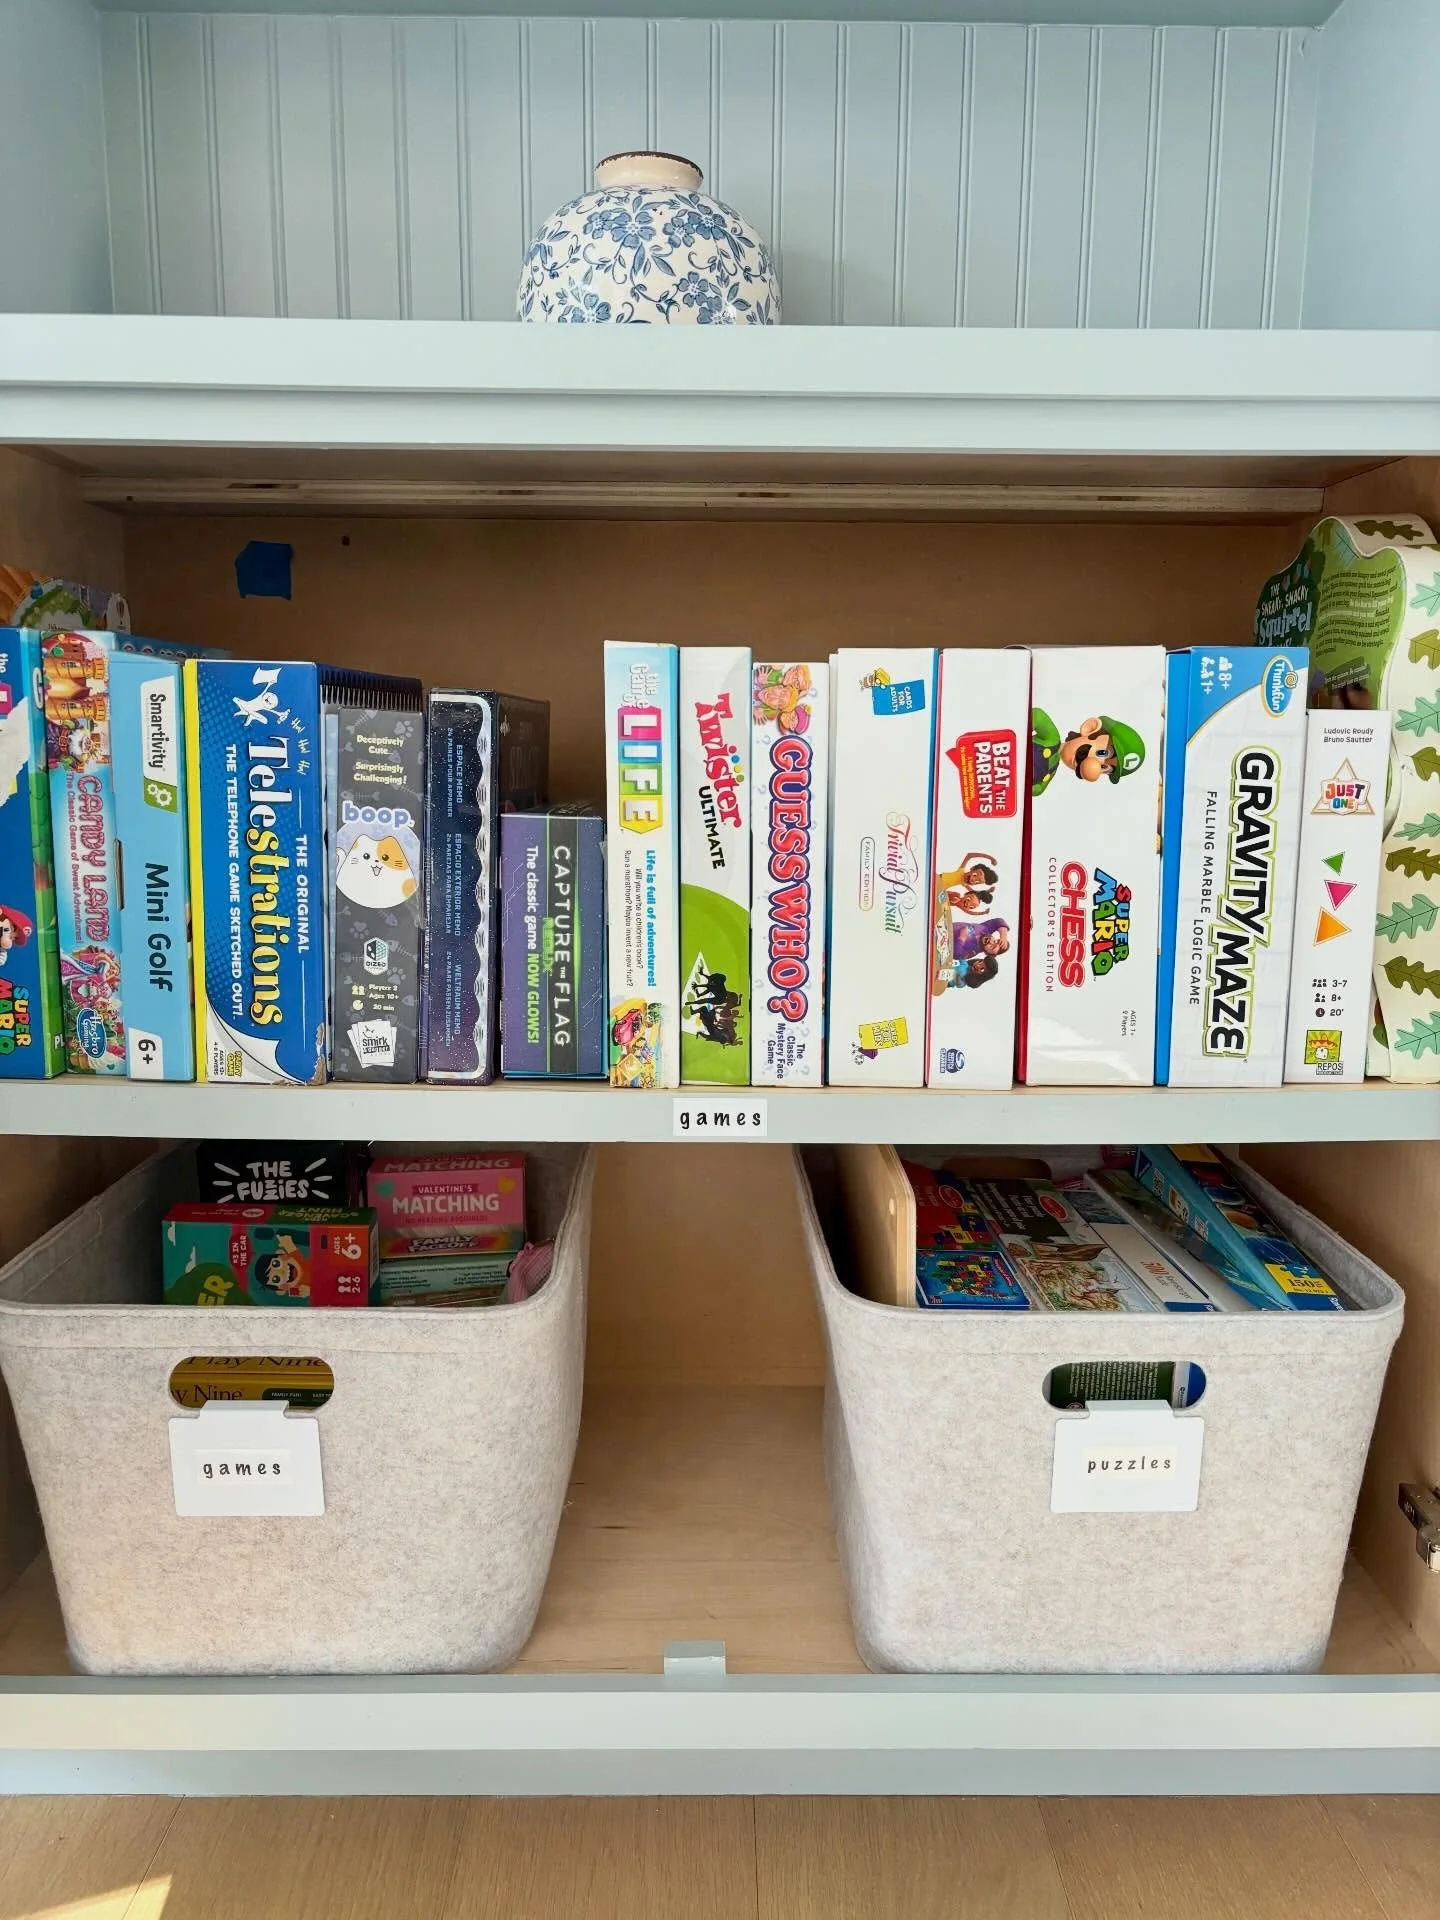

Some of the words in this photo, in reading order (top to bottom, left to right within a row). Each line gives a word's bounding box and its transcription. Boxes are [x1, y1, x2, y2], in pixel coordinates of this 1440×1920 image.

[1200, 680, 1214, 695] 1+
[1218, 673, 1232, 690] 8+
[148, 693, 170, 768] Smartivity
[356, 734, 404, 747] Deceptively
[226, 744, 236, 772] THE
[356, 762, 404, 774] Surprisingly
[623, 714, 658, 822] LIFE
[695, 692, 744, 828] Twister
[992, 741, 1010, 787] BEAT
[354, 773, 408, 784] Challenging!
[974, 742, 992, 814] PARENTS
[1326, 784, 1366, 800] JUST
[68, 791, 76, 822] Classic
[770, 737, 811, 882] GUESS
[995, 790, 1006, 811] THE
[1332, 798, 1356, 809] ONE
[78, 776, 107, 867] CANDY
[226, 777, 238, 858] TELEPHONE
[698, 785, 726, 870] ULTIMATE
[1204, 791, 1217, 850] FALLING
[69, 824, 78, 850] Game
[296, 834, 308, 867] THE
[1226, 752, 1274, 935] GRAVITY
[70, 852, 79, 862] of
[527, 846, 538, 869] The
[624, 850, 632, 862] Run
[646, 850, 656, 871] Life
[72, 864, 80, 890] Sweet
[229, 862, 240, 902] GAME
[246, 736, 293, 1025] Telestrations
[624, 869, 632, 904] marathon?
[634, 880, 642, 893] you
[635, 868, 643, 880] Will
[646, 874, 656, 883] is
[1201, 856, 1214, 914] MARBLE
[83, 874, 110, 942] LAND
[145, 862, 170, 922] Mini
[527, 872, 538, 912] classic
[554, 846, 570, 962] CAPTURE
[646, 886, 656, 904] full
[1046, 857, 1056, 938] COLLECTOR'S
[296, 874, 309, 954] ORIGINAL
[646, 907, 656, 920] of
[1058, 862, 1088, 988] CHESS
[1092, 868, 1118, 976] MARIO
[1114, 883, 1132, 963] SUPER
[230, 906, 242, 978] SKETCHED
[524, 915, 536, 950] game
[1192, 920, 1204, 960] LOGIC
[148, 934, 172, 992] Golf
[647, 922, 656, 986] adventures!
[769, 882, 809, 1021] WHO?
[1045, 944, 1055, 992] EDITION
[454, 964, 462, 1009] WELTRAUM
[527, 953, 539, 988] NOW
[1190, 966, 1202, 1005] GAME
[1332, 980, 1348, 988] 3-7
[231, 983, 243, 1016] OUT!
[1210, 931, 1250, 1050] MAZE
[1331, 994, 1342, 1002] 8+
[14, 985, 32, 1047] SUPER
[527, 990, 539, 1044] GLOWS!
[554, 982, 570, 1047] FLAG
[1330, 1008, 1344, 1016] 20'
[82, 1018, 90, 1048] Gaming
[89, 1014, 102, 1054] Hasbro
[775, 1022, 786, 1056] Mystery
[138, 1038, 156, 1065] 6+
[767, 1040, 776, 1064] Game
[786, 1036, 796, 1066] Classic
[797, 1044, 806, 1060] The
[1318, 1062, 1343, 1070] REPOS
[776, 1058, 786, 1079] Face
[680, 1112, 760, 1130] games
[246, 1160, 292, 1178] THE
[384, 1158, 512, 1172] MATCHING
[392, 1194, 500, 1214] MATCHING
[418, 1184, 472, 1194] VALENTINE'S
[240, 1252, 248, 1266] THE
[342, 1232, 362, 1260] 6+
[194, 1385, 243, 1400] Nine
[203, 1463, 280, 1479] games
[1088, 1456, 1171, 1474] puzzles
